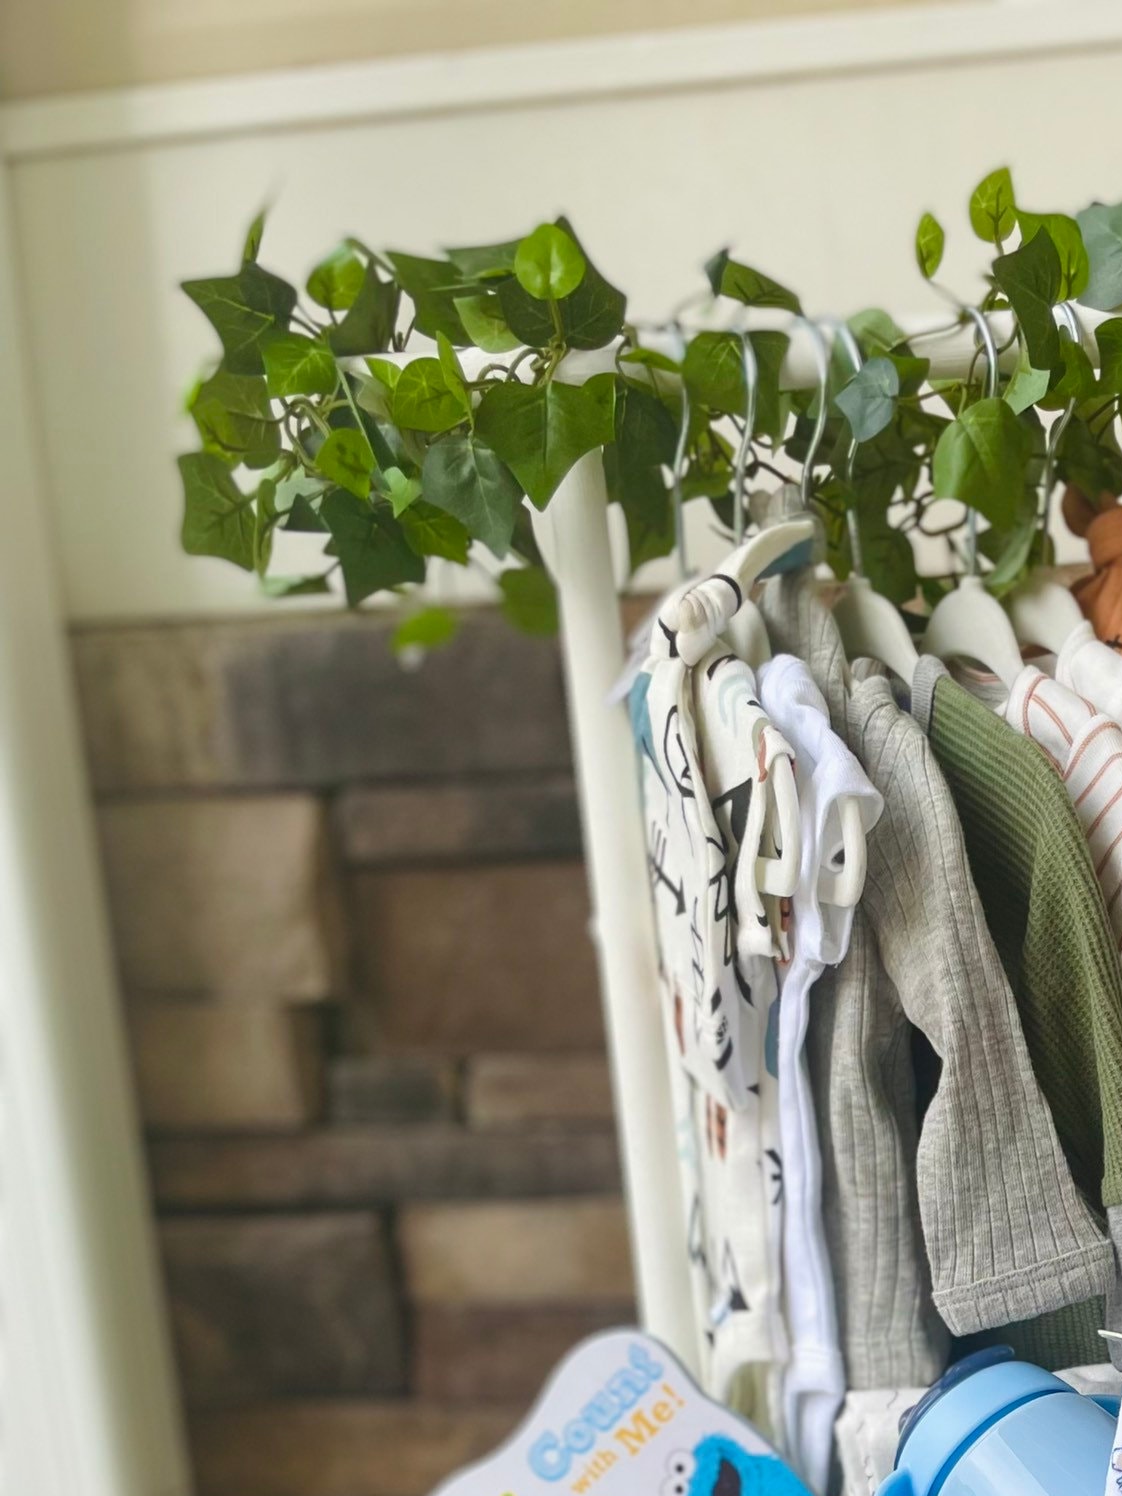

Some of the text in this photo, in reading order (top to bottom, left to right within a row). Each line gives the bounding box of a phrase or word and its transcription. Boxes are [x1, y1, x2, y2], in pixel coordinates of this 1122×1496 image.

[527, 1342, 665, 1482] Count
[570, 1383, 686, 1495] with Me!
